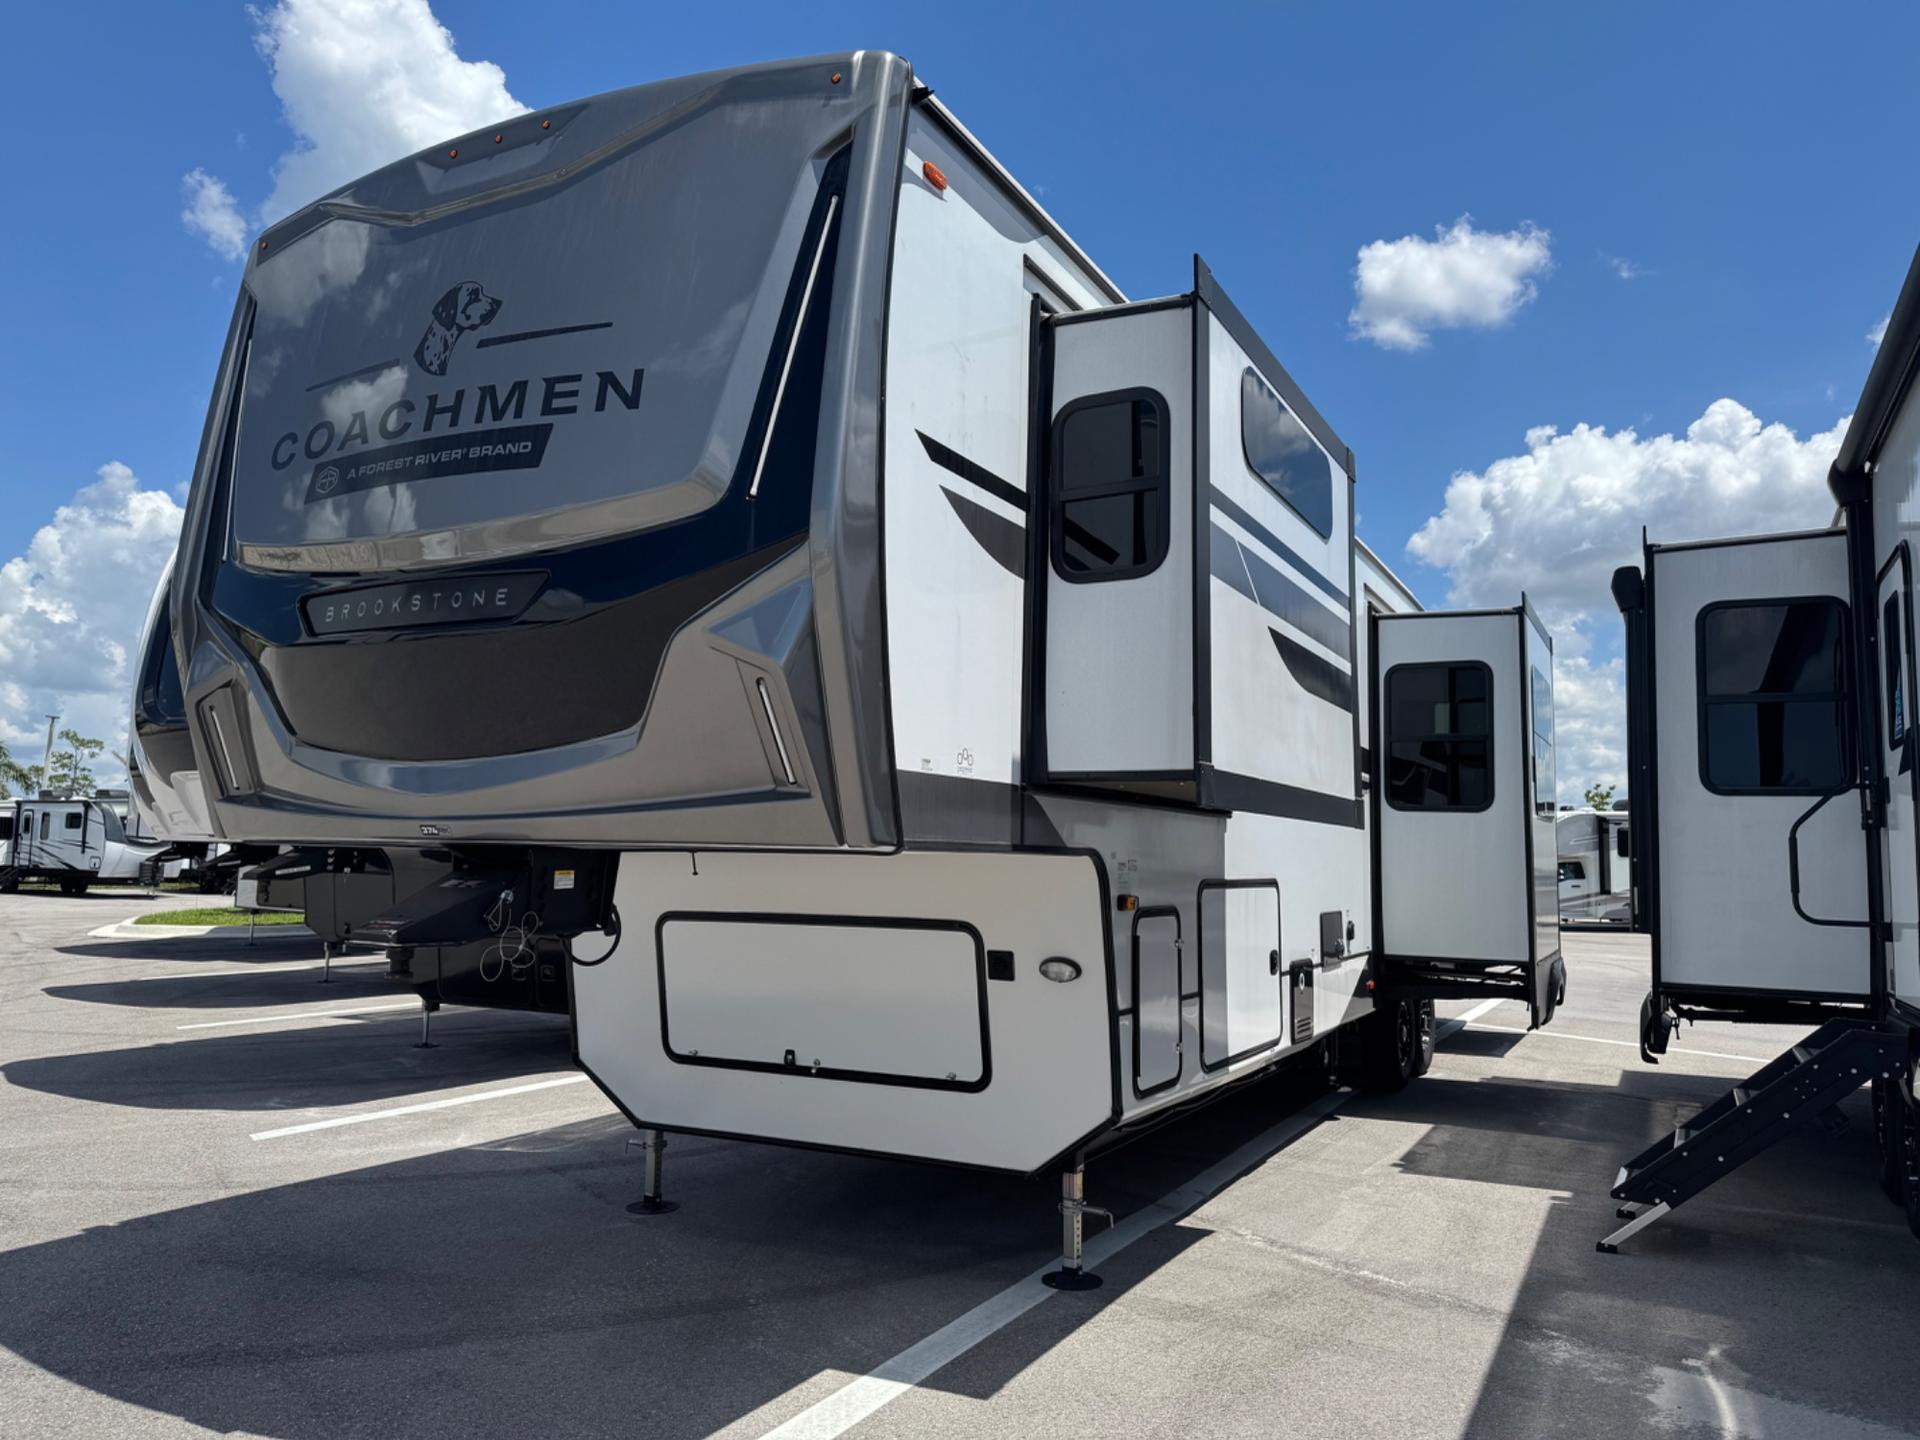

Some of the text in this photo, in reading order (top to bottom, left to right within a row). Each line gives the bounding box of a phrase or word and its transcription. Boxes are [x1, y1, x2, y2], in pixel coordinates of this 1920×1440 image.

[271, 368, 644, 471] COACHMEN
[346, 467, 357, 480] A
[358, 456, 413, 477] FOREST
[469, 441, 532, 458] BRAND
[325, 588, 508, 623] BROOKSTONE
